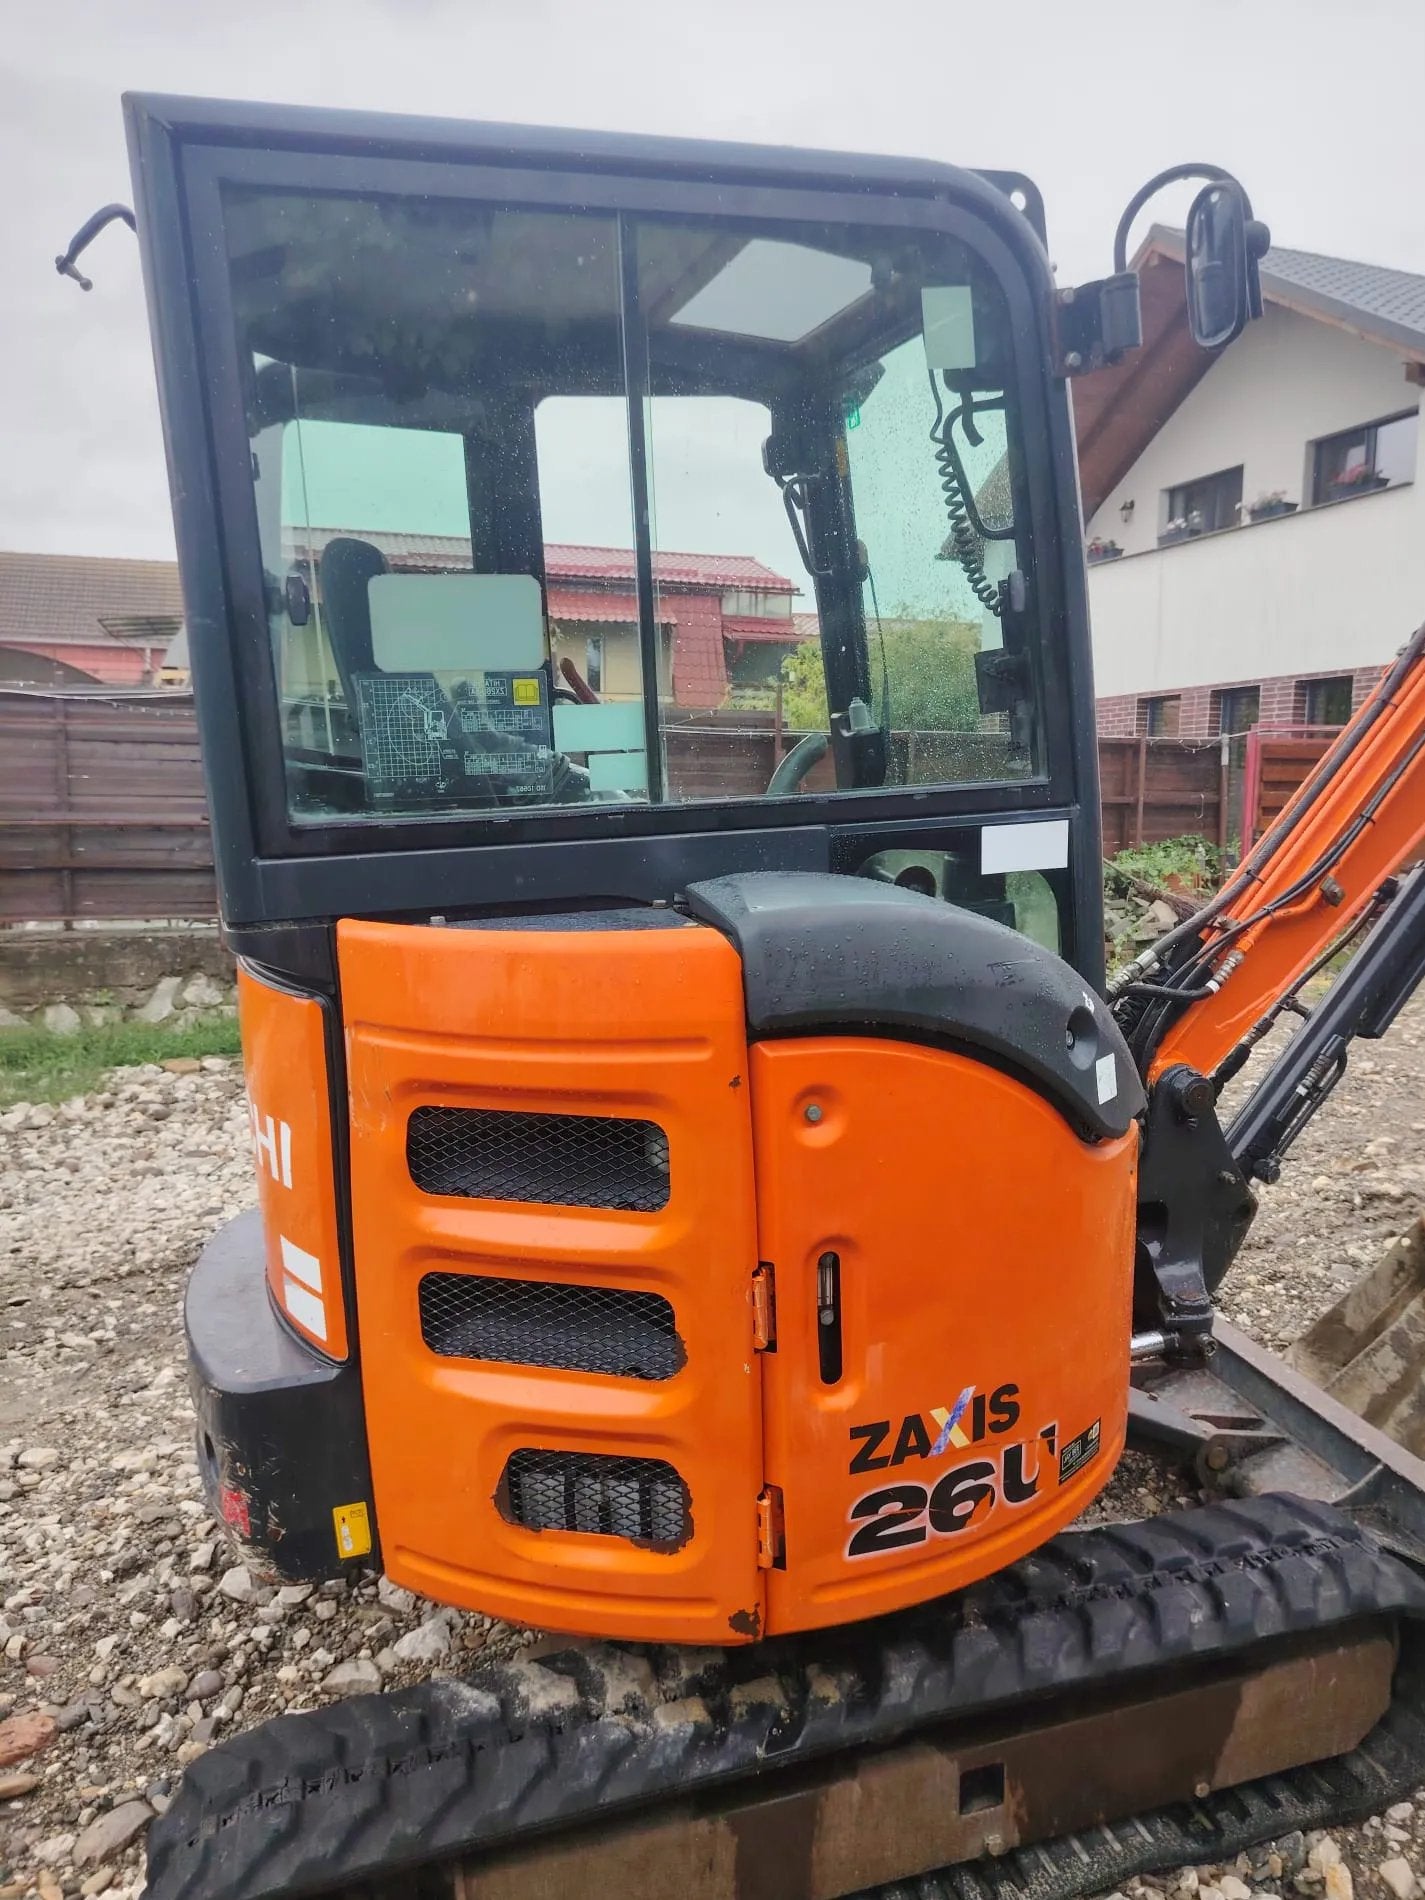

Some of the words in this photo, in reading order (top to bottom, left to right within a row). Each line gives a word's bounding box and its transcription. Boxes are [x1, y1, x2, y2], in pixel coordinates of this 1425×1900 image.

[251, 1103, 293, 1190] HI
[848, 1383, 1021, 1476] ZAXIS
[846, 1422, 1058, 1559] 26U
